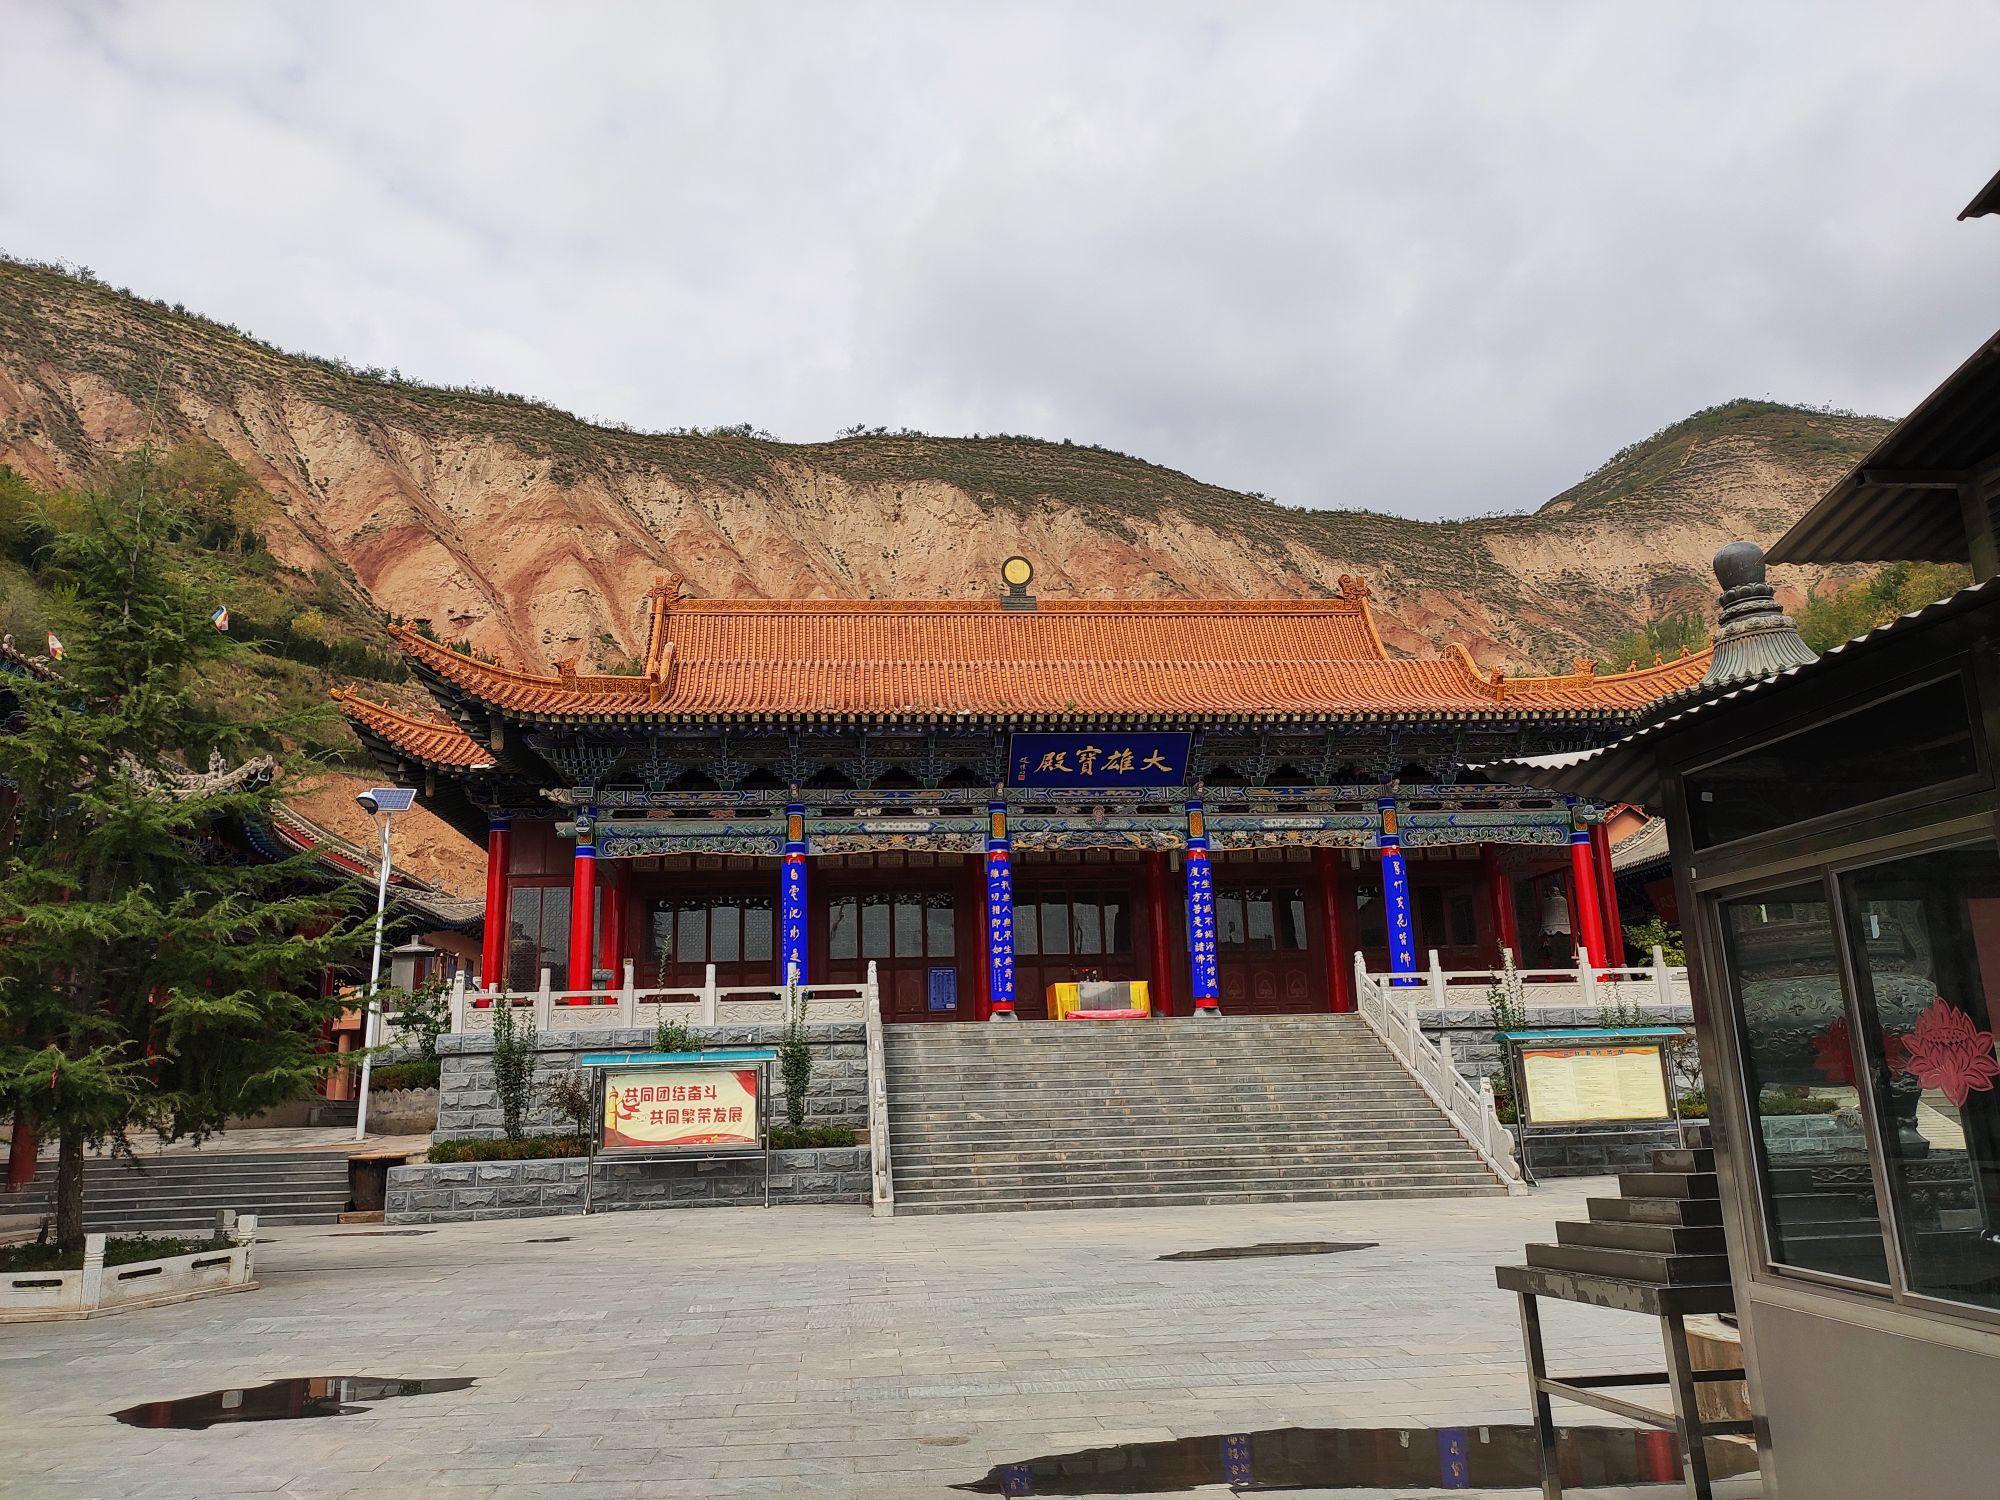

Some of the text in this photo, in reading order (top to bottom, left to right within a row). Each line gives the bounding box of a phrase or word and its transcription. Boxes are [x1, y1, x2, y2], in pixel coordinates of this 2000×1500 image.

[1033, 745, 1173, 775] 大雄寶殿
[625, 1084, 718, 1103] 共同团结奋斗
[649, 1106, 743, 1125] 共同繁荣发展
